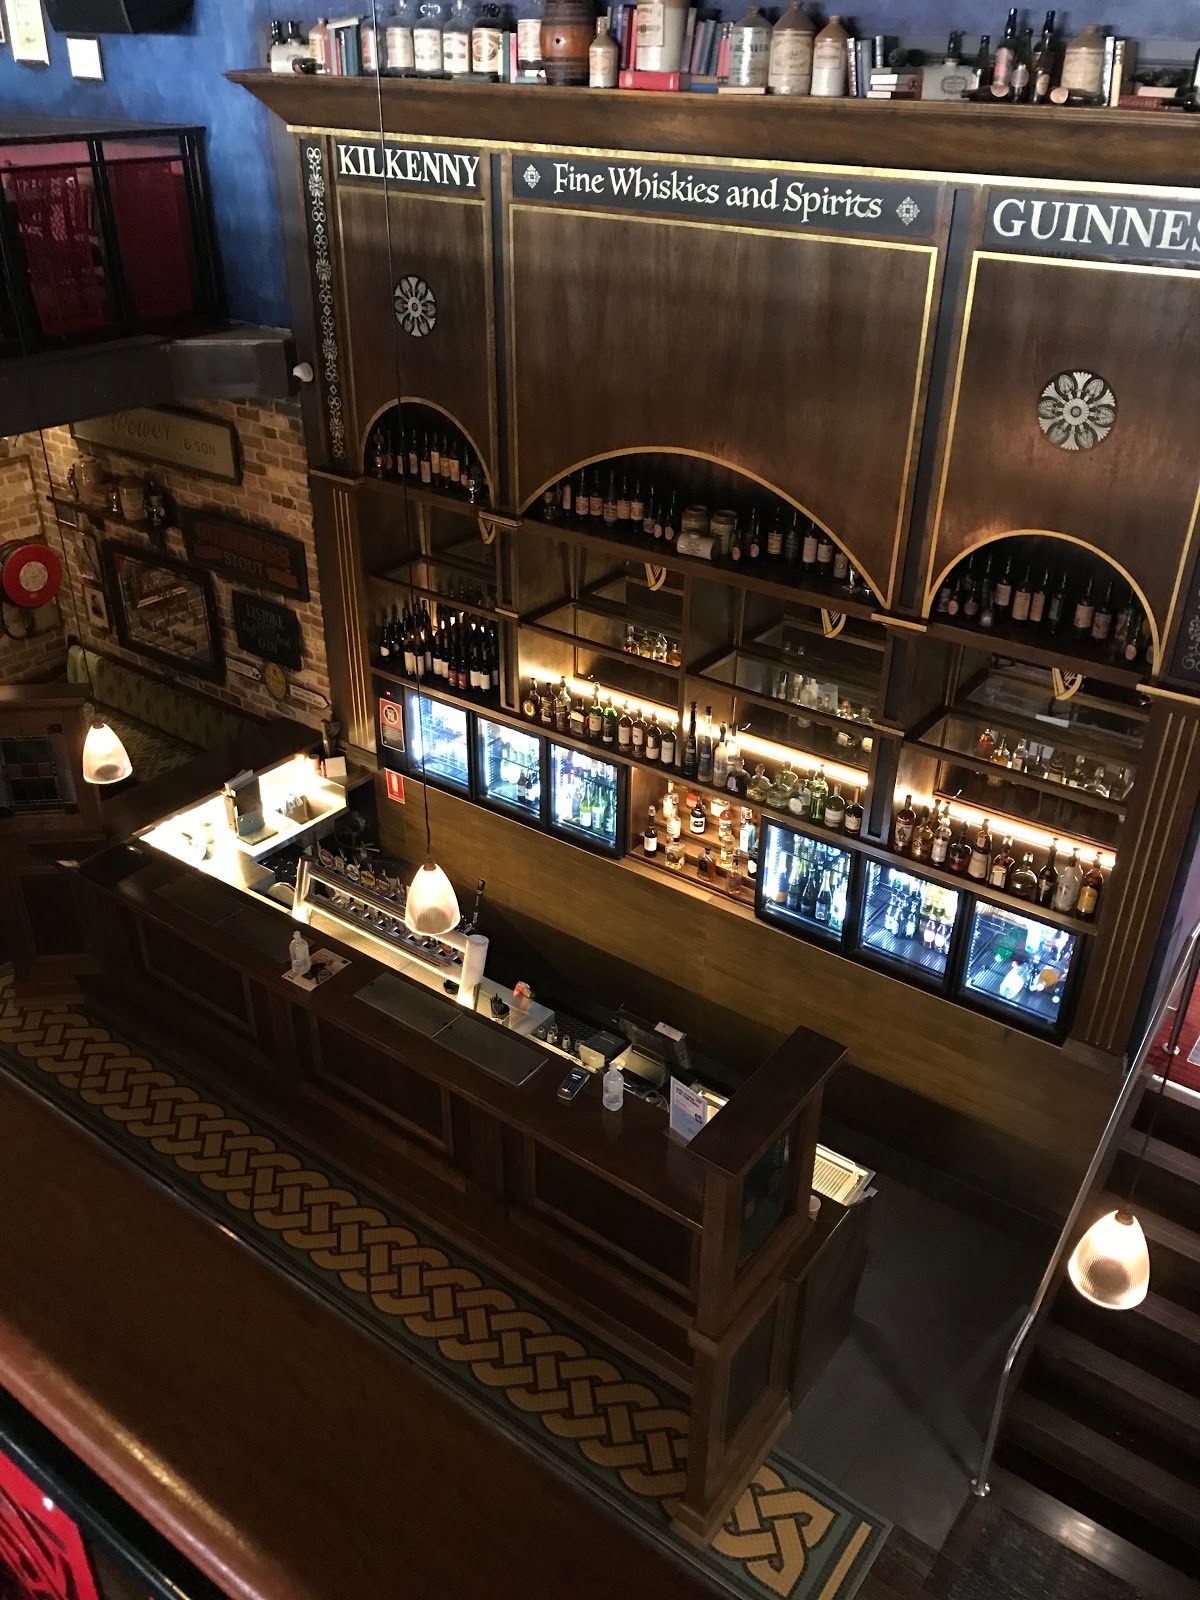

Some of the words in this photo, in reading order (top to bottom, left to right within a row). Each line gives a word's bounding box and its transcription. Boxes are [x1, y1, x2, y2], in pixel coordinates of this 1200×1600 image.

[337, 145, 479, 187] KILKENNY
[553, 162, 605, 194] Fine
[608, 167, 720, 204] Whiskies
[726, 177, 780, 210] and
[782, 181, 884, 223] Spirits
[194, 440, 217, 457] SON
[223, 550, 264, 576] STOUT
